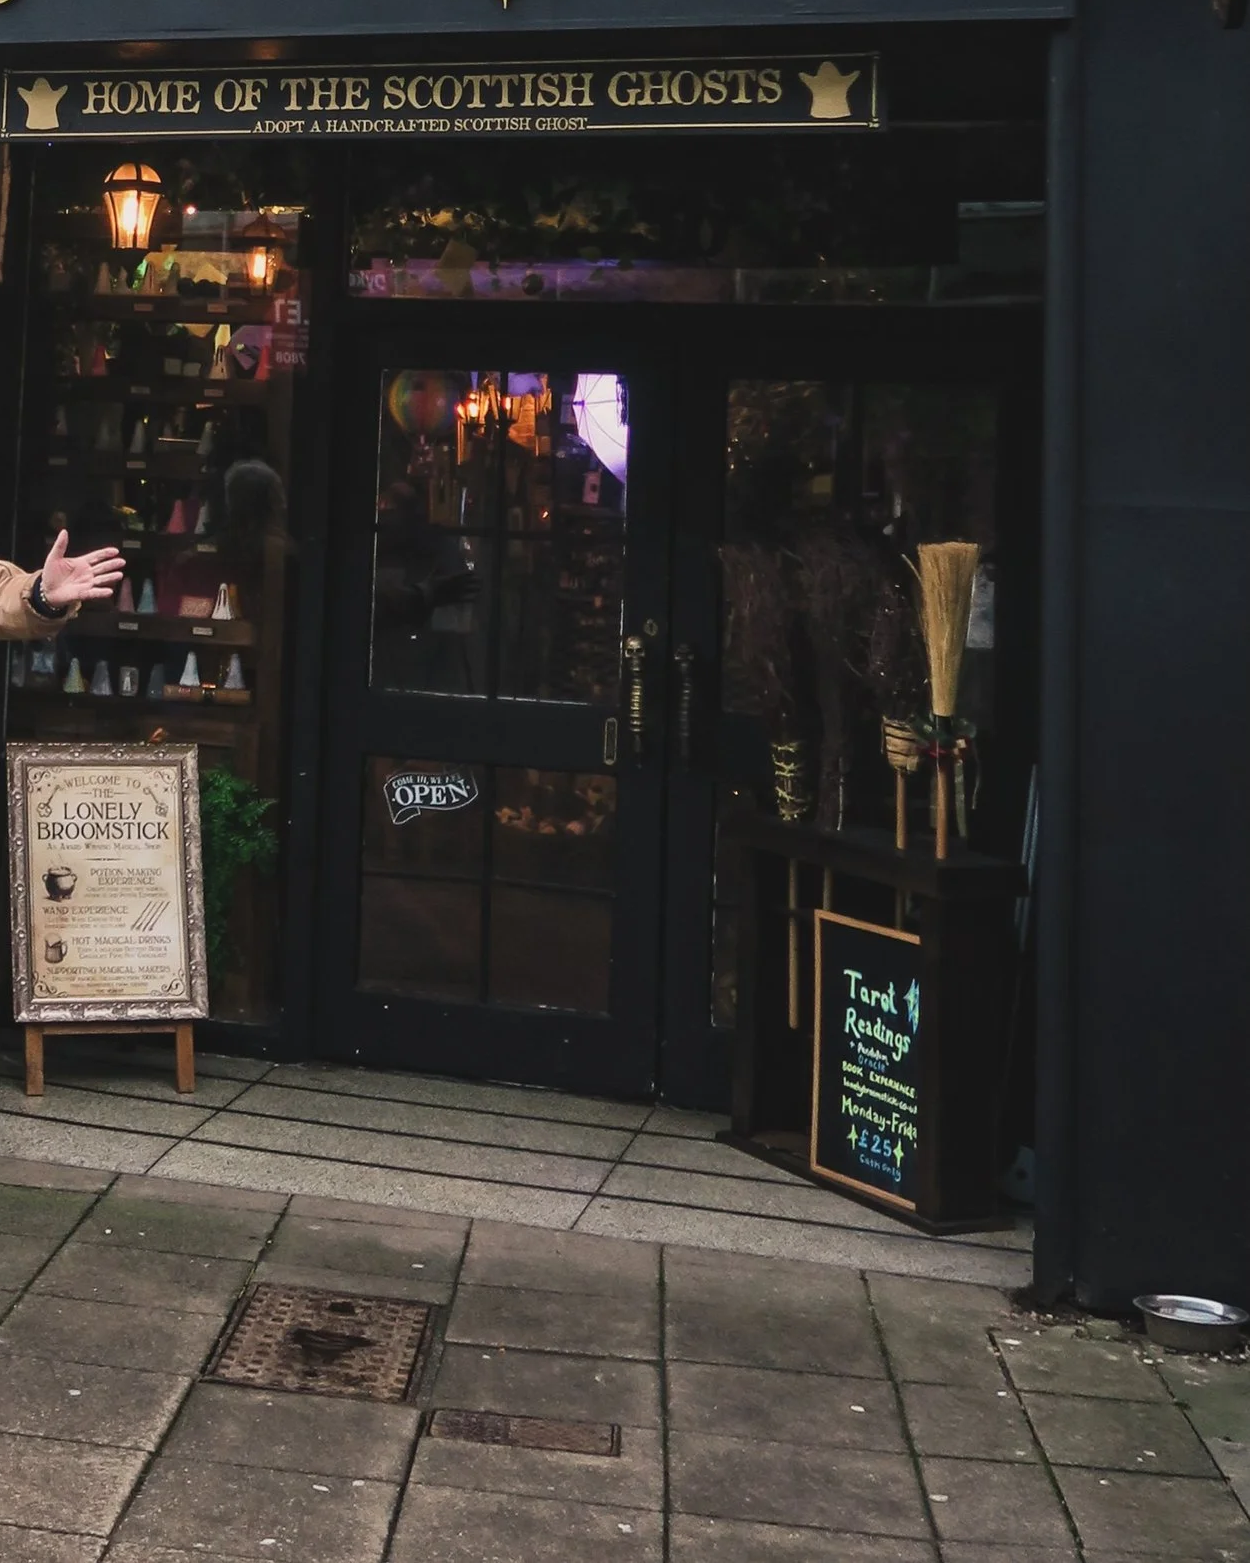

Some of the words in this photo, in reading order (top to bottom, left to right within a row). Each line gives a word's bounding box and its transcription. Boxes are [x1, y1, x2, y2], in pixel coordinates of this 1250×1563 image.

[82, 80, 200, 115] HOME
[214, 77, 267, 112] OF
[280, 75, 368, 111] THE
[383, 71, 594, 110] SCOTTISH
[607, 68, 783, 106] GHOSTS
[252, 119, 305, 134] ADOPT
[310, 119, 322, 133] A
[327, 118, 450, 134] HANDCRAFTED
[454, 117, 531, 132] SCOTTISH
[535, 116, 587, 131] GHOST
[64, 775, 121, 788] WELCOME
[126, 777, 142, 789] TO
[93, 788, 114, 798] THE
[395, 779, 469, 806] OPEN
[63, 802, 142, 820] LONELY
[37, 822, 170, 840] BROOMSTICK
[42, 906, 69, 915] WAND
[72, 906, 129, 915] EXPERIENCE
[72, 937, 91, 946] HOT
[95, 936, 137, 945] MAGICAL
[139, 936, 172, 944] DRINKS
[46, 966, 97, 975] SUPPORTING
[99, 966, 135, 974] MAGICAL
[843, 969, 898, 1015] Tarot
[844, 1007, 911, 1062] Readings
[842, 1094, 918, 1150] Monday-Frida
[858, 1128, 893, 1158] £25
